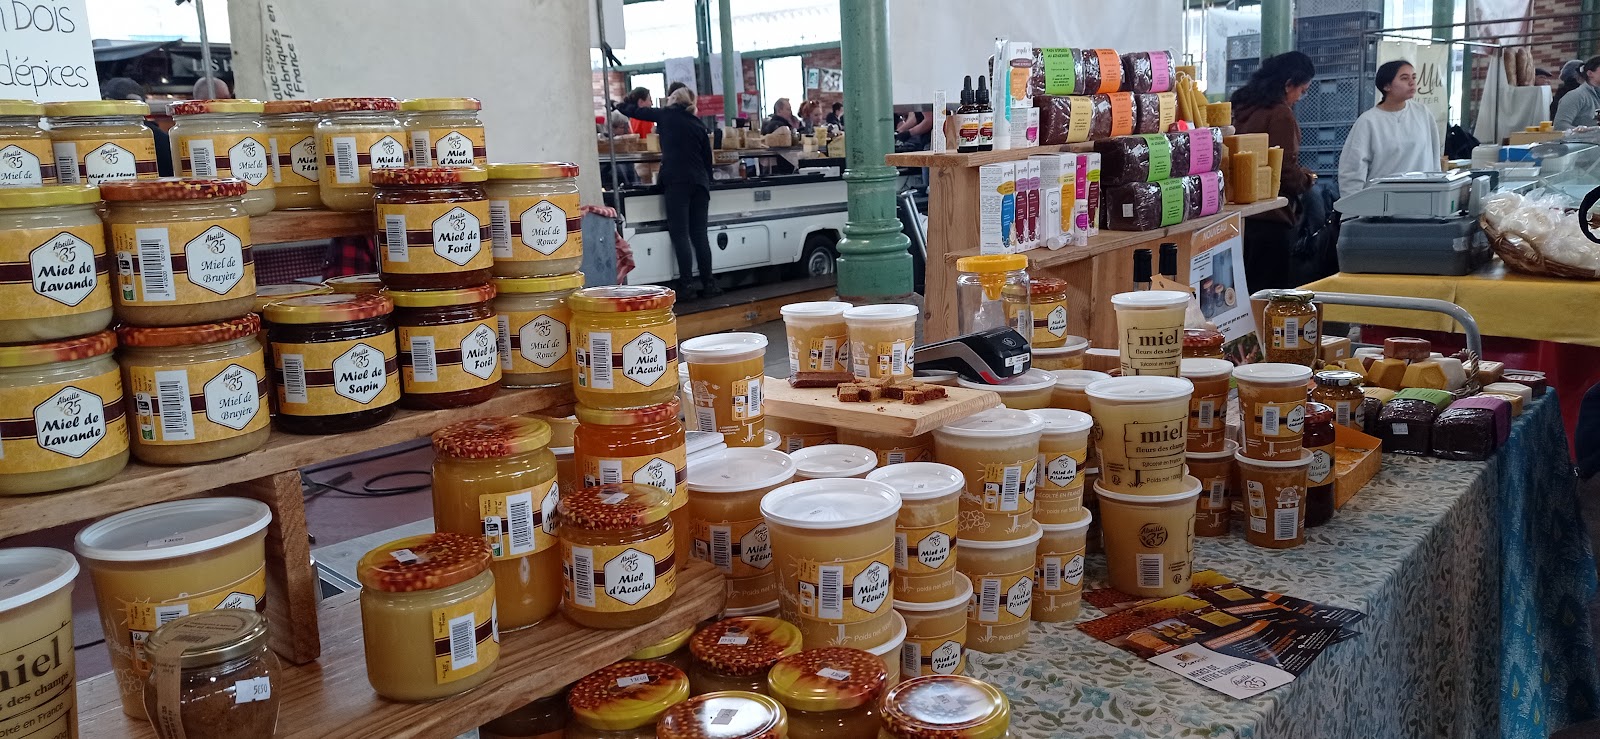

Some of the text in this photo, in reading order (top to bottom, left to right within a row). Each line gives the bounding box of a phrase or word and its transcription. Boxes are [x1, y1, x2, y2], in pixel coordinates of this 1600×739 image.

[266, 4, 295, 98] fabriqués en
[287, 43, 304, 93] France
[10, 156, 23, 168] 35
[105, 153, 119, 165] 35
[239, 161, 256, 169] Miel
[440, 157, 472, 165] d'Acacia
[1, 172, 22, 180] Miel
[243, 171, 263, 180] Ronce
[538, 211, 553, 223] 35
[451, 220, 466, 232] 35
[532, 226, 561, 237] Miel de
[1202, 222, 1228, 241] NOUVEAU
[205, 232, 225, 243] Abeille
[438, 231, 478, 242] Miel de
[536, 238, 558, 247] Ronce
[53, 238, 75, 250] Abeille
[211, 238, 227, 254] 35
[447, 242, 472, 254] Forêt
[59, 246, 76, 263] 35
[38, 261, 92, 278] Miel de
[201, 258, 236, 272] Miel de
[203, 271, 237, 284] Bruyère
[39, 277, 94, 293] Lavande
[537, 325, 551, 337] 35
[531, 339, 560, 349] Miel de
[1139, 329, 1179, 347] miel
[351, 348, 368, 359] Abeille
[467, 348, 488, 359] Miel
[640, 342, 654, 355] 35
[355, 354, 370, 368] 35
[536, 351, 557, 360] Ronce
[635, 355, 658, 365] Miel
[475, 357, 493, 369] Forêt
[223, 370, 241, 380] Abeille
[339, 368, 382, 383] Miel de
[628, 364, 664, 375] d'Acacia
[227, 375, 243, 391] 35
[348, 383, 379, 395] Sapin
[57, 392, 80, 405] Abeille
[219, 394, 252, 409] Miel de
[63, 400, 82, 415] 35
[221, 406, 253, 420] Bruyère
[42, 413, 99, 432] Miel de
[43, 428, 101, 446] Lavande
[1140, 420, 1183, 443] miel
[1147, 532, 1164, 546] 35
[746, 545, 767, 554] Miel
[921, 549, 938, 557] Miel
[620, 553, 638, 563] Abeille
[624, 558, 639, 572] 35
[618, 572, 644, 584] Miel
[609, 582, 651, 595] d'Acacia
[858, 583, 878, 595] Miel
[7, 672, 69, 710] des champs
[24, 717, 35, 729] en
[38, 702, 64, 725] France
